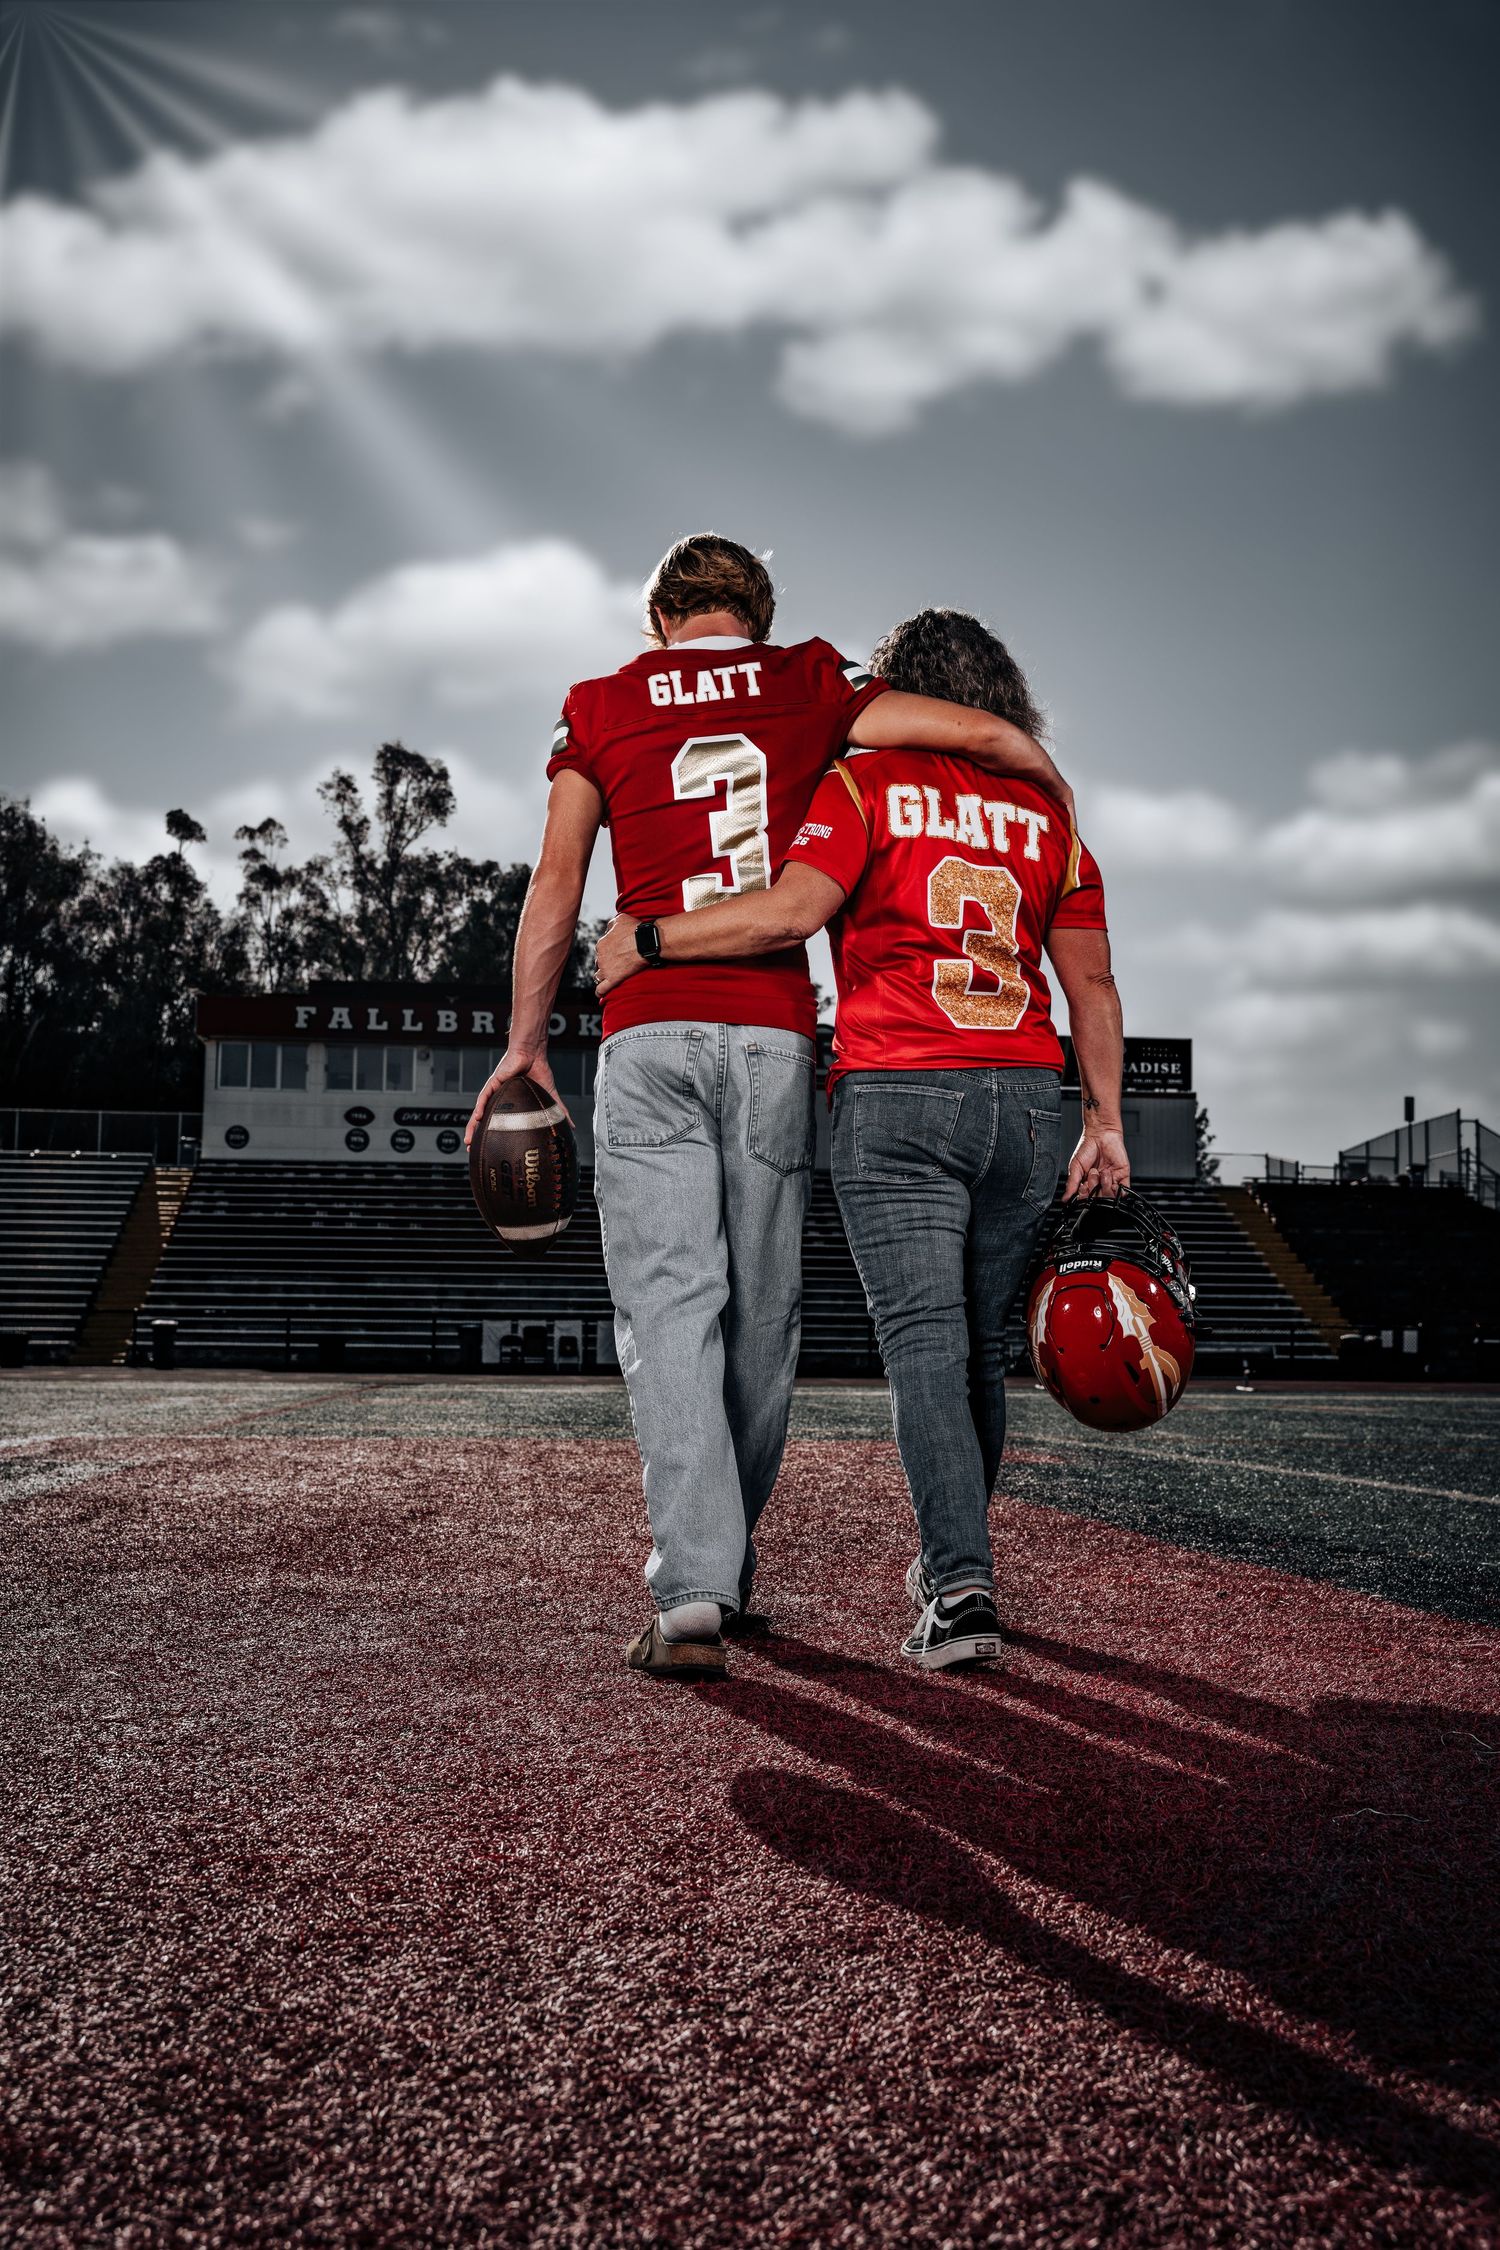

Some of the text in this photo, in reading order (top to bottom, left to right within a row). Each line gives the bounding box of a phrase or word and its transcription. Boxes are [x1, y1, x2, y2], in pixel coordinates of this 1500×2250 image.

[648, 662, 762, 706] GLATT
[671, 733, 771, 911] 3
[886, 784, 1049, 861] GLATT
[927, 856, 1030, 1030] 3
[294, 1006, 602, 1036] FALLBROK
[1124, 1062, 1182, 1075] ADISE
[524, 1147, 541, 1208] Wilson
[1058, 1260, 1102, 1273] Riddell
